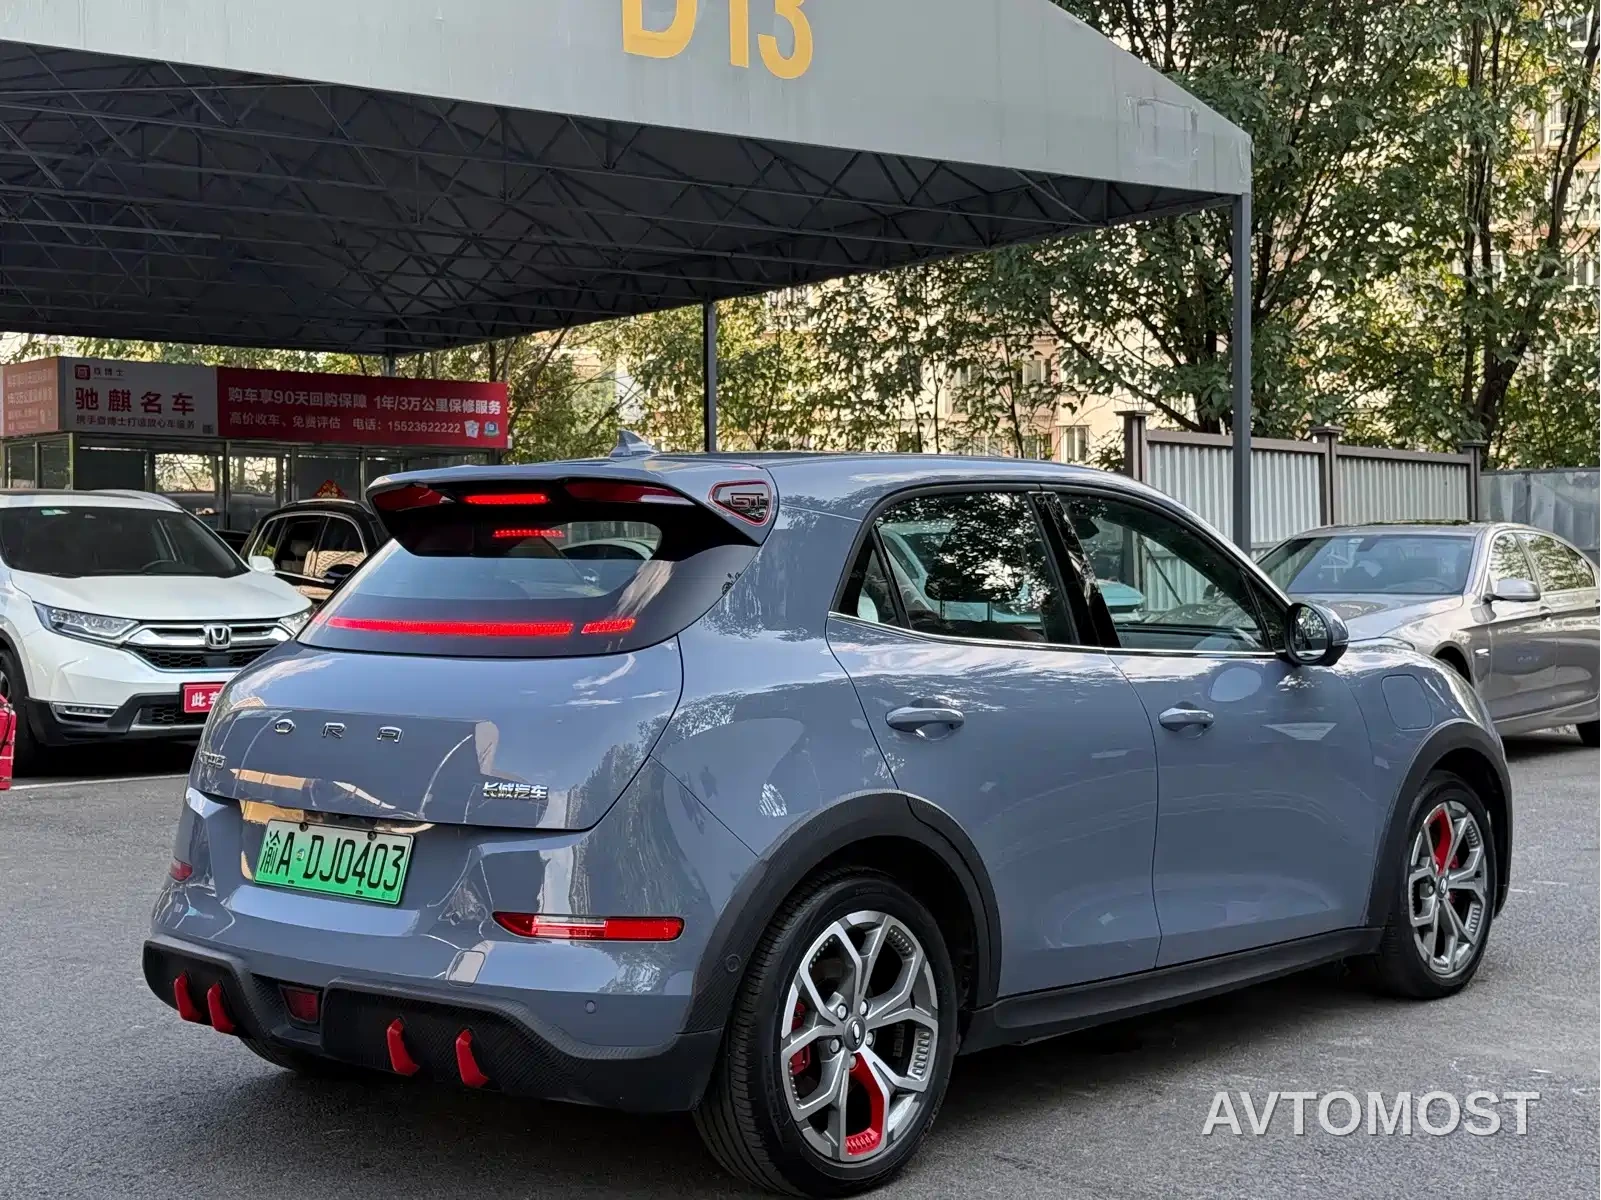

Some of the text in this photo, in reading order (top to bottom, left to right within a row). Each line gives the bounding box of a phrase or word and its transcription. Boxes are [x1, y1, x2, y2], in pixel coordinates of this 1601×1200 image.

[75, 387, 195, 415] 驰麒名车
[228, 387, 501, 415] 购车享90天回购保障 1年/3万公里保修服务
[229, 411, 341, 430] 高价收车、免费评估
[387, 420, 461, 434] 15523622222
[274, 718, 404, 743] ORA
[483, 781, 549, 800] 长城汽车
